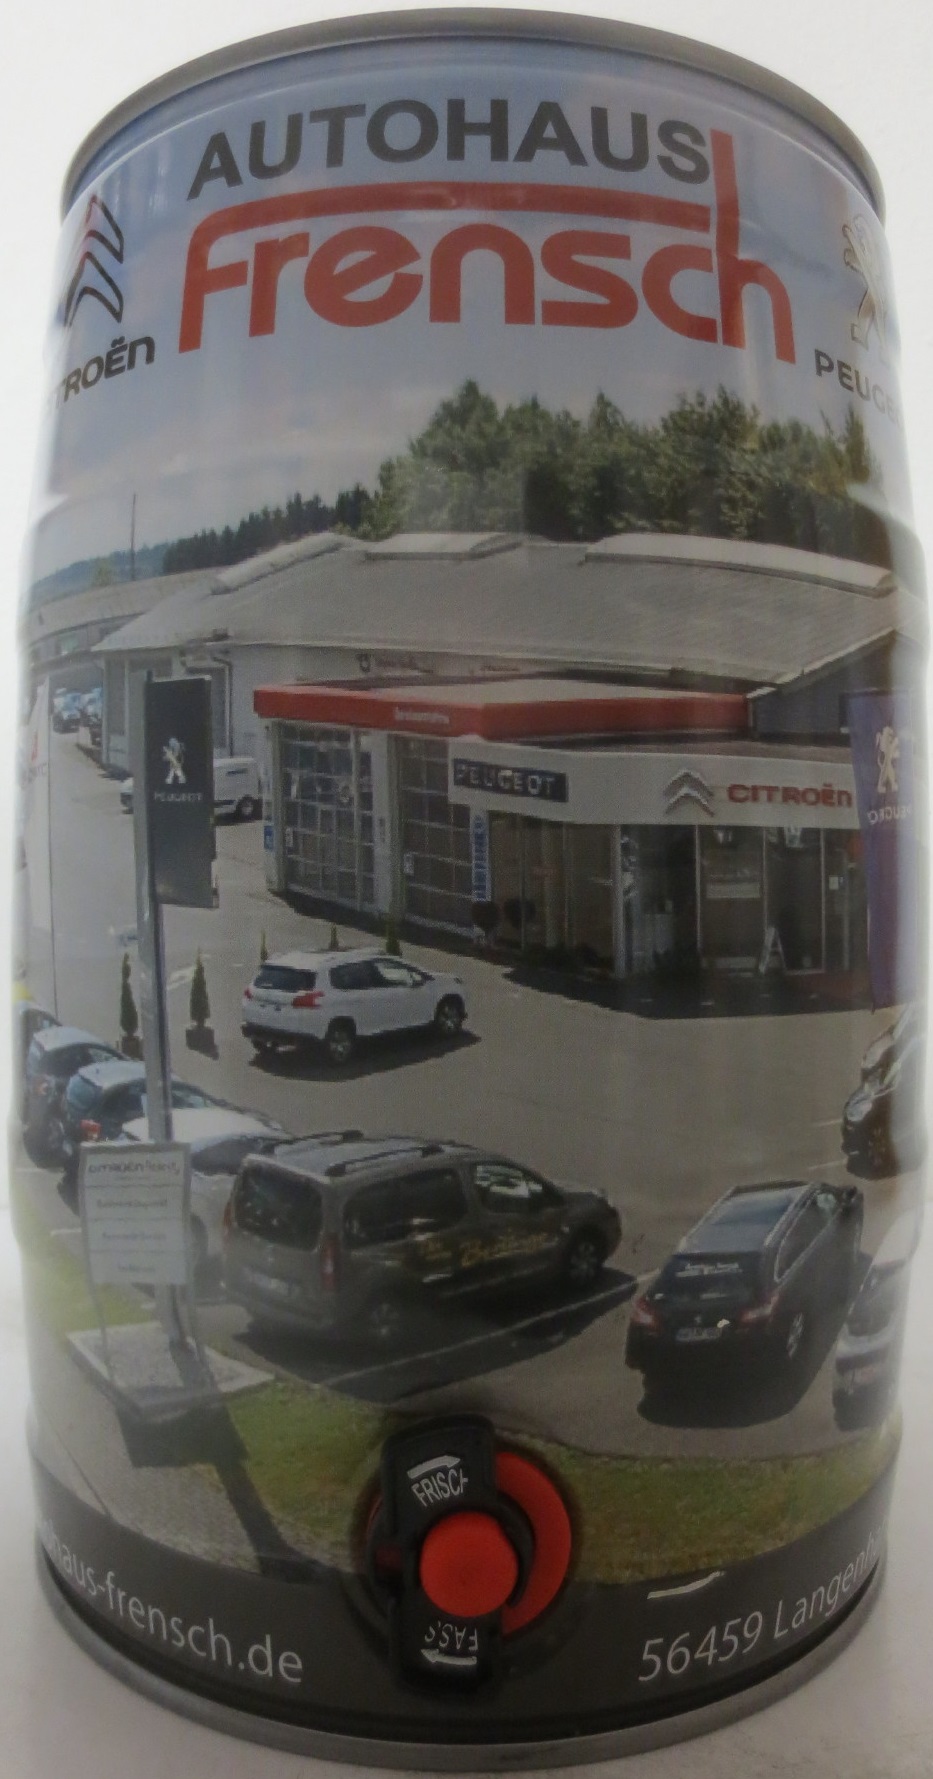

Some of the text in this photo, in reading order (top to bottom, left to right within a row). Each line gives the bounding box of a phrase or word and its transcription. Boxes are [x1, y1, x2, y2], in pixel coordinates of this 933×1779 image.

[187, 98, 711, 201] AUTOHAUS
[456, 762, 557, 796] PEUGEOT
[638, 1611, 763, 1682] 56459
